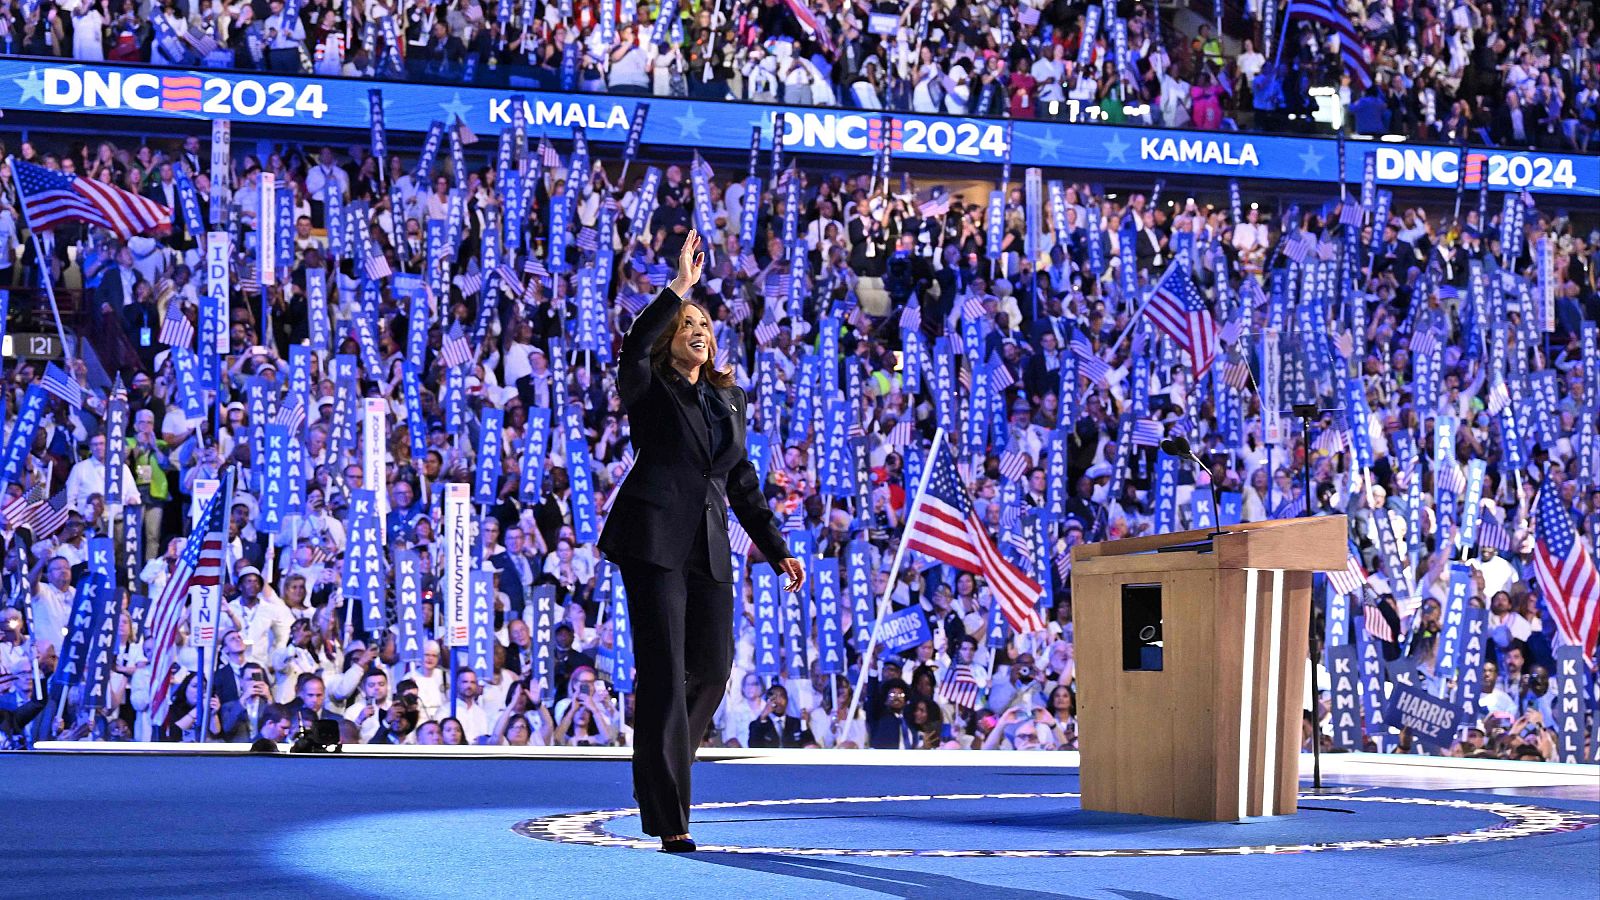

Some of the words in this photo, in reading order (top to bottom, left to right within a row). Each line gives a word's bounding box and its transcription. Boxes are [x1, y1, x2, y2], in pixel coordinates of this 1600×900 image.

[1081, 12, 1097, 58] KAMALA
[44, 68, 160, 110] DNC
[203, 78, 328, 119] 2024
[902, 119, 1014, 157] 2024
[1140, 137, 1260, 166] KAMALA
[1375, 147, 1459, 183] DNC
[1489, 155, 1576, 187] 2024
[281, 196, 290, 259] KAMALA
[329, 186, 341, 247] KAMALA
[507, 178, 517, 242] KAMALA
[553, 203, 565, 265] KAMALA
[634, 173, 657, 228] KAMALA
[697, 176, 711, 231] KAMALA
[744, 184, 757, 240] KAMALA
[786, 185, 796, 240] KAMALA
[991, 198, 1001, 253] KAMALA
[1053, 187, 1067, 239] KAMALA
[431, 226, 442, 290] KAMALA
[1089, 214, 1100, 268] KAMALA
[1123, 237, 1136, 292] KAMALA
[311, 277, 324, 342] KAMALA
[582, 277, 593, 342] KAMALA
[793, 247, 804, 310] KAMALA
[1473, 266, 1487, 323] KAMALA
[30, 338, 51, 354] 121
[203, 306, 214, 381] KAMALA
[358, 317, 381, 375] KAMALA
[411, 297, 425, 365] KAMALA
[823, 326, 834, 391] KAMALA
[907, 332, 917, 386] AMALA
[178, 346, 199, 409] AMALA
[406, 371, 423, 449] KAMALA
[451, 366, 462, 425] AMALA
[761, 361, 773, 431] KAMALA
[794, 362, 812, 432] KAMALA
[938, 354, 951, 425] KAMALA
[971, 374, 988, 447] KAMALA
[1061, 358, 1075, 426] KAMALA
[1134, 357, 1147, 411] AMALA
[1417, 354, 1427, 405] AMALA
[6, 396, 42, 474] KAMALA
[252, 387, 266, 465] KAMALA
[1229, 387, 1238, 442] AMALA
[1351, 390, 1370, 459] KAMALA
[1581, 412, 1591, 477] KAMALA
[110, 411, 122, 493] KAMALA
[268, 437, 281, 522] KAMALA
[287, 437, 301, 505] AMALA
[480, 418, 497, 496] KAMALA
[524, 417, 544, 493] KAMALA
[827, 411, 846, 487] KAMALA
[1053, 440, 1063, 514] KAMALA
[572, 452, 592, 533] KAMALA
[857, 446, 870, 521] KAMALA
[1161, 460, 1174, 534] KAMALA
[1410, 473, 1420, 546] KAMALA
[1464, 468, 1482, 538] KAMALA
[126, 513, 137, 592] KAMALA
[365, 528, 381, 619] KAMALA
[455, 503, 465, 622] TENNESSEE
[1379, 519, 1408, 592] KAMALA
[64, 583, 97, 675] KAMALA
[401, 560, 419, 651] KAMALA
[474, 581, 488, 670] KAMALA
[759, 574, 775, 666] KAMALA
[786, 577, 804, 668] AMALA
[821, 571, 839, 663] KAMALA
[852, 553, 870, 641] KAMALA
[1441, 582, 1467, 669] KAMALA
[90, 600, 117, 696] KAMALA
[538, 598, 551, 690] KAMALA
[615, 586, 626, 681] KAMALA
[1462, 619, 1482, 715] KAMALA
[1336, 658, 1354, 751] KAMAL
[1396, 691, 1455, 729] HARRIS
[1401, 714, 1441, 738] WALZ
